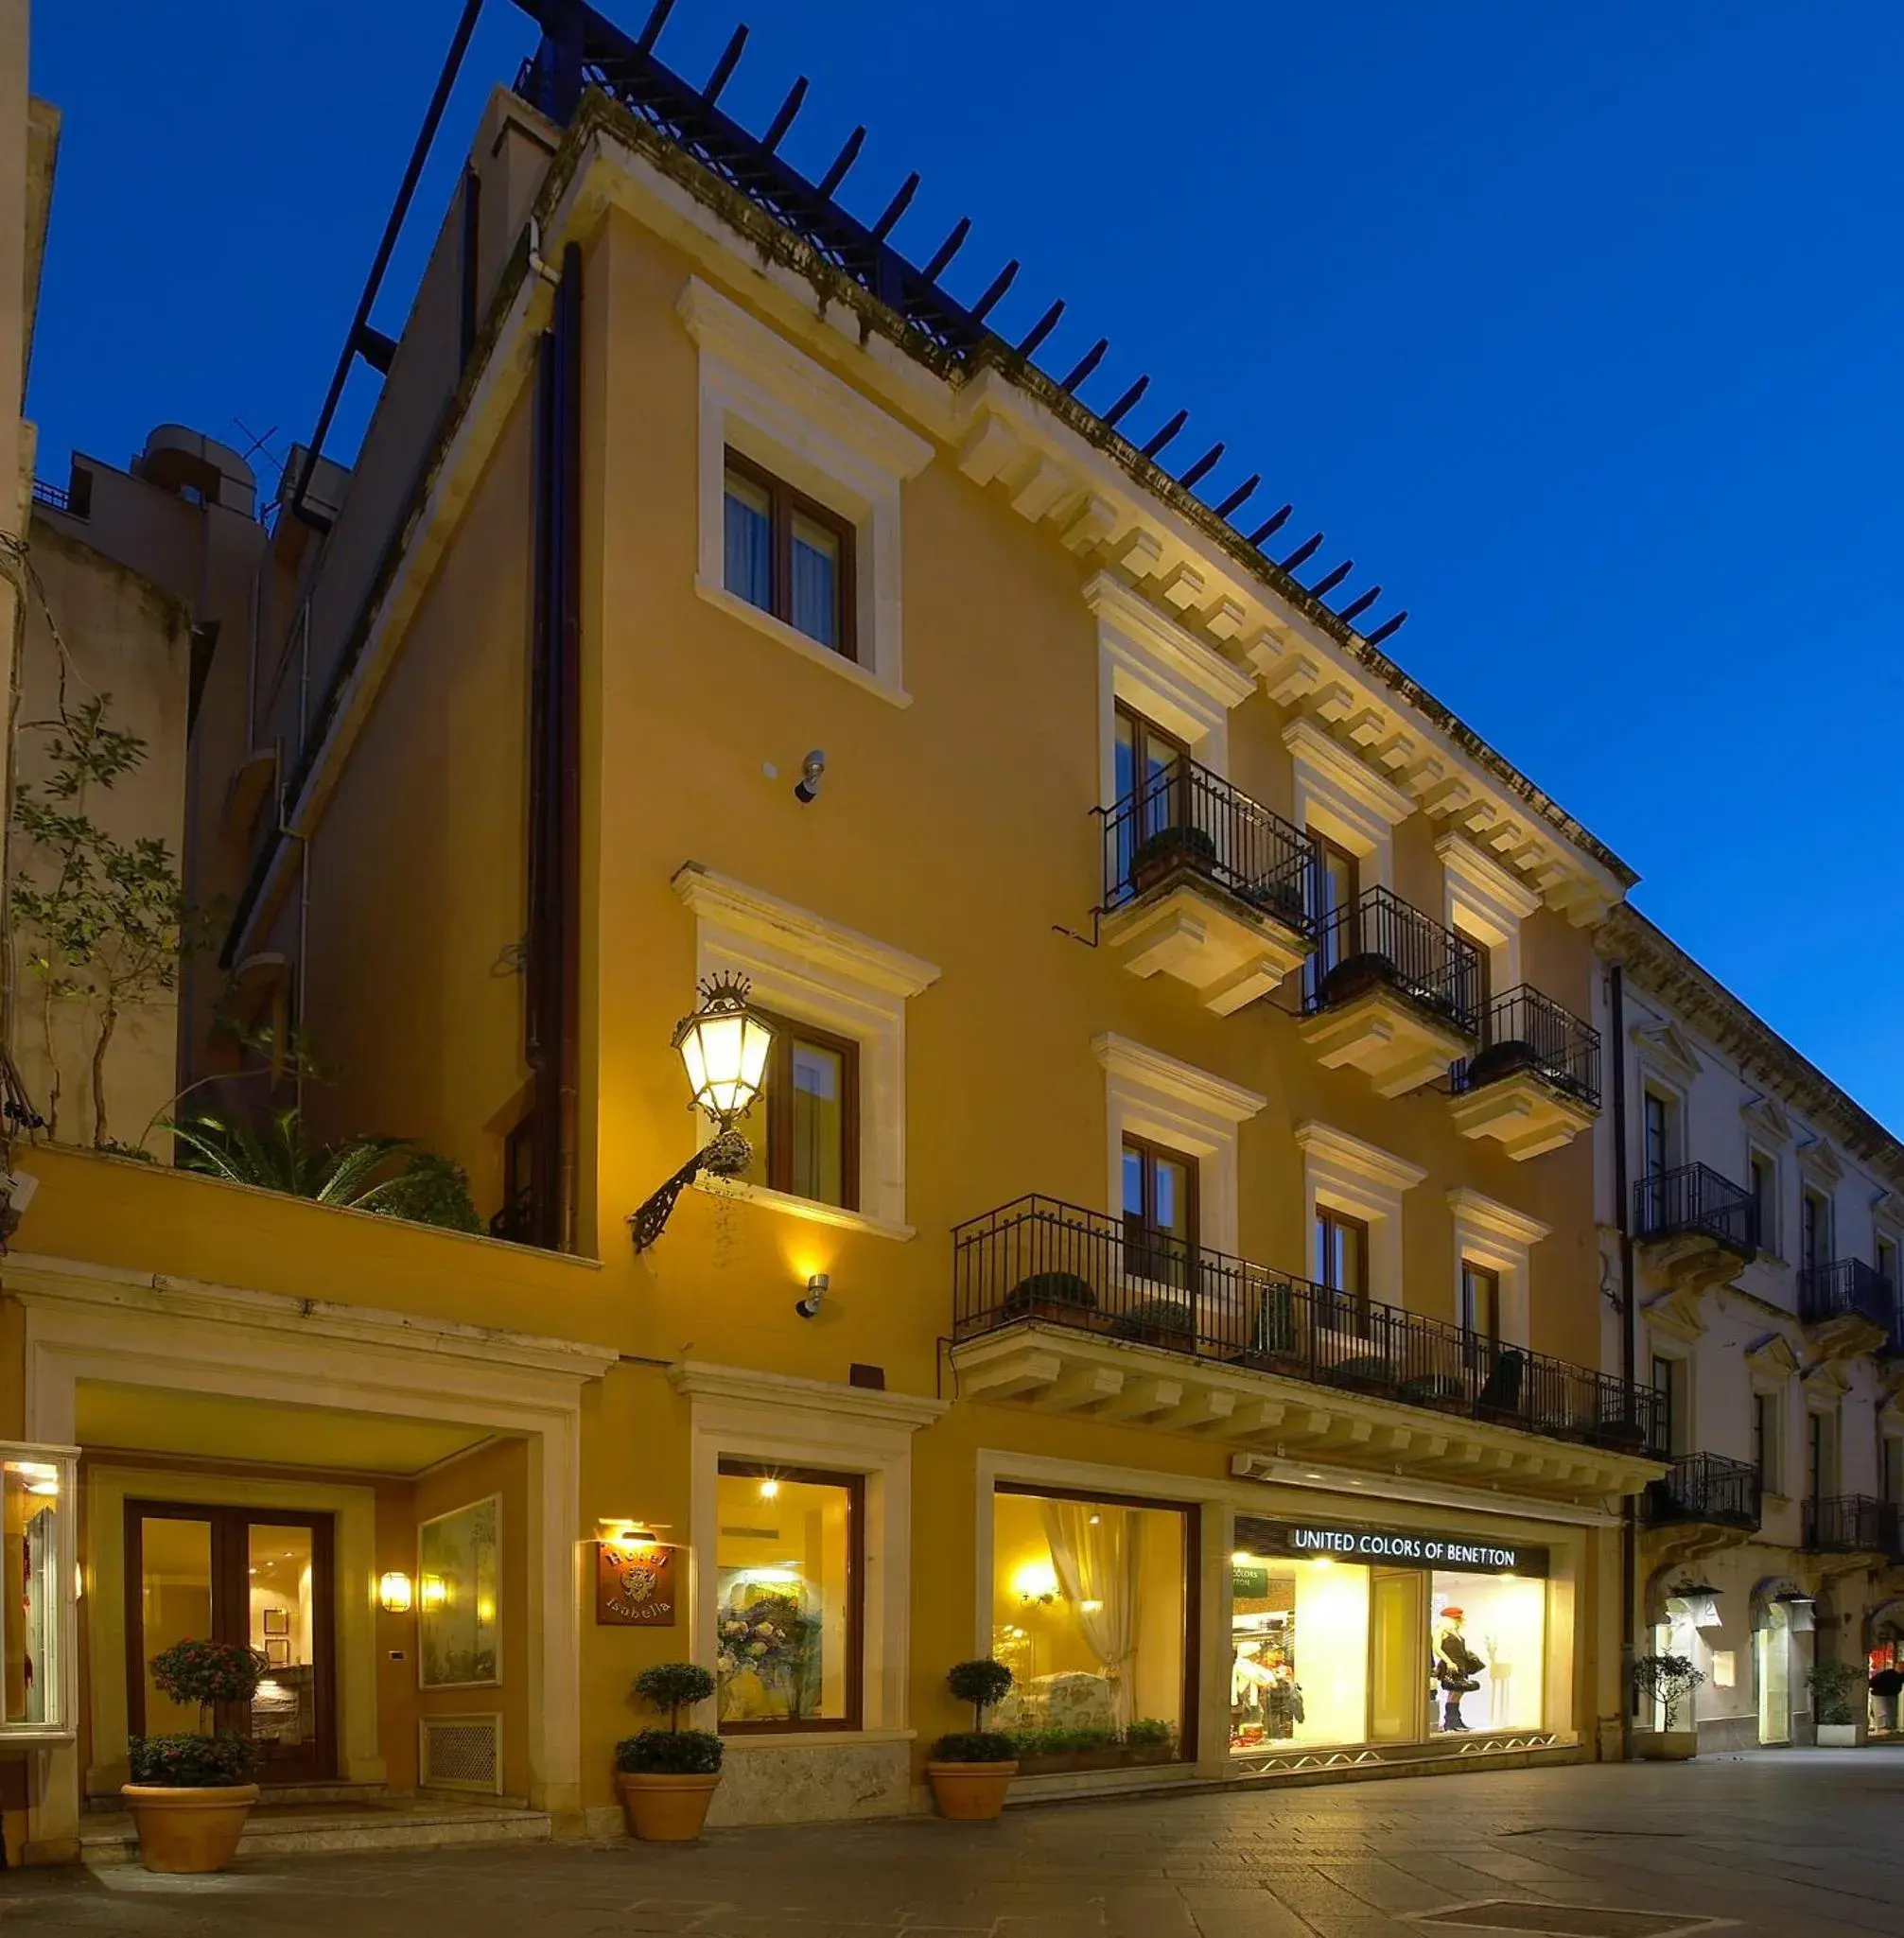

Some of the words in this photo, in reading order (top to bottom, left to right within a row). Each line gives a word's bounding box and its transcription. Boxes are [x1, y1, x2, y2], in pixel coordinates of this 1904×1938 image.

[1295, 1528, 1354, 1552] UNITED
[1359, 1535, 1421, 1558] COLORS
[1424, 1542, 1444, 1560] OF
[1447, 1544, 1515, 1566] BENETTON
[606, 1551, 668, 1567] Hotel
[605, 1597, 672, 1619] Isabella
